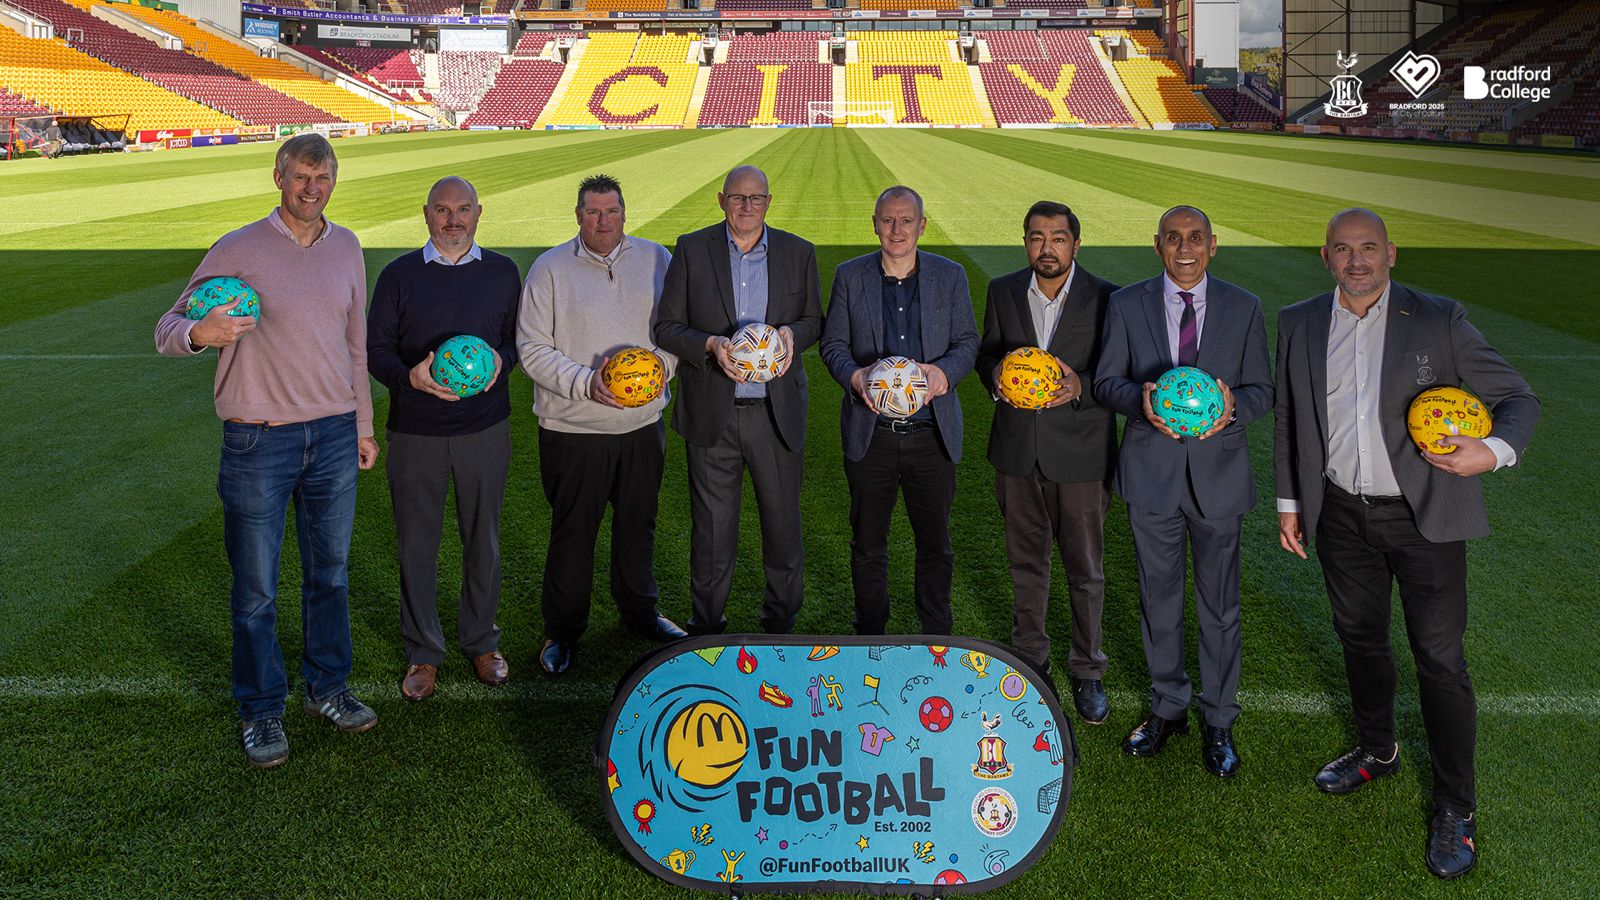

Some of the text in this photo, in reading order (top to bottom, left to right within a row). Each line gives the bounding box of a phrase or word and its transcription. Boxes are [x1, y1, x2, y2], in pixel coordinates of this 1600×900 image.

[282, 9, 301, 17] Smith
[303, 10, 323, 18] Butler
[325, 12, 370, 21] Accountants
[381, 15, 414, 23] Business
[339, 31, 371, 39] BRADFORD
[586, 63, 1086, 125] CITY
[753, 726, 843, 772] FUN
[735, 757, 945, 825] FOOTBALL
[874, 821, 931, 833] Est. 2002
[973, 816, 1017, 836] COMMUNITY FOUNDATION
[759, 857, 910, 877] @FunFootballUK
